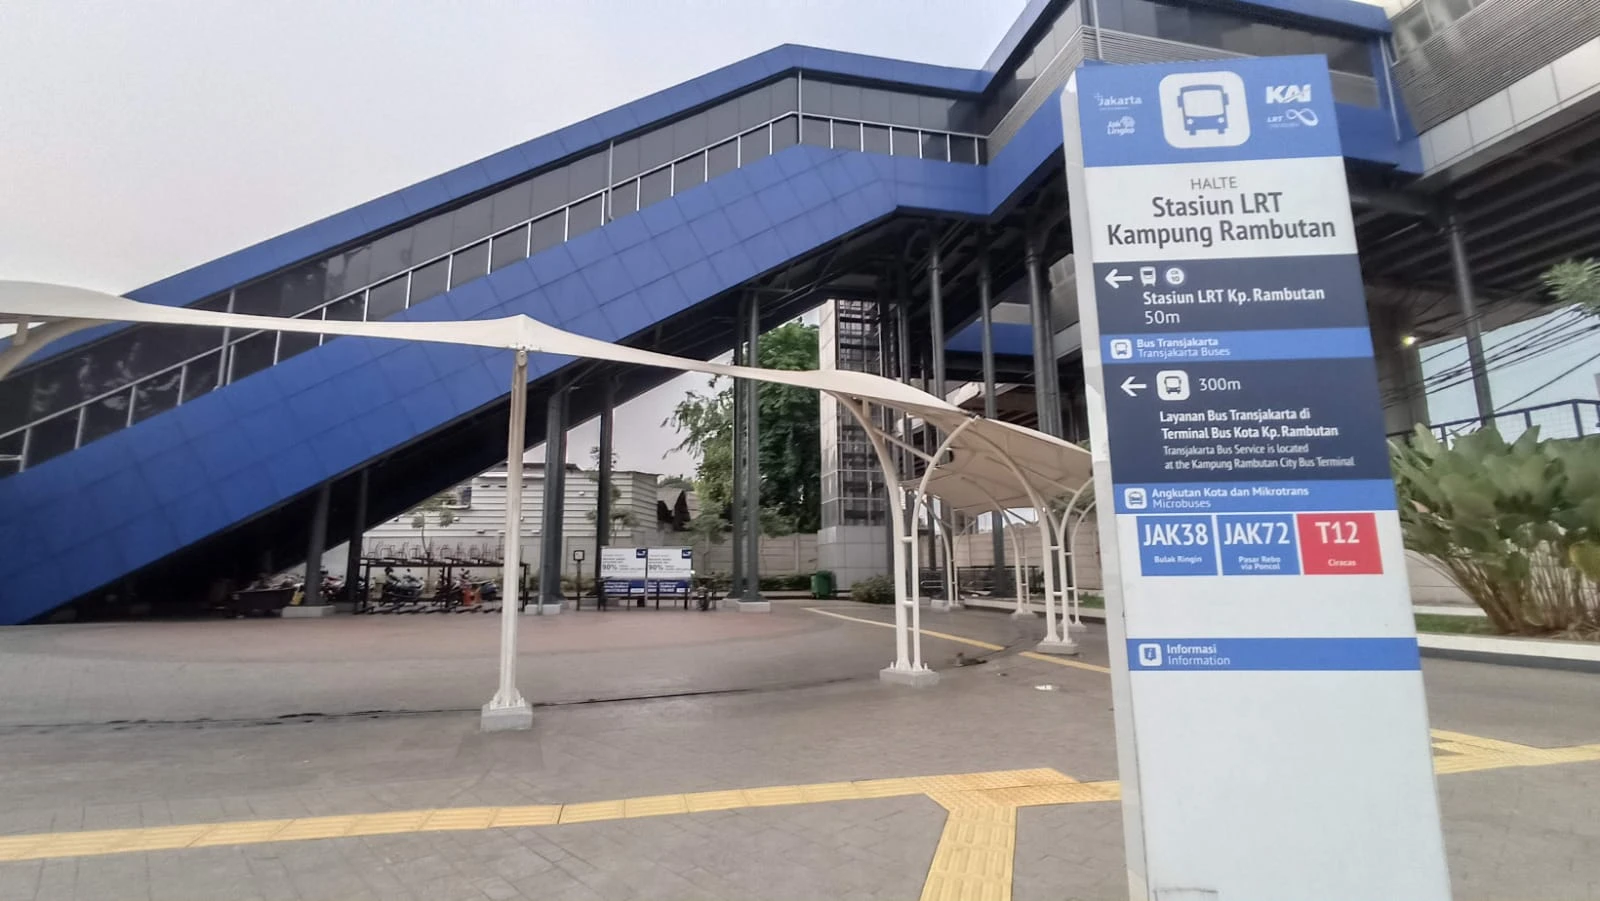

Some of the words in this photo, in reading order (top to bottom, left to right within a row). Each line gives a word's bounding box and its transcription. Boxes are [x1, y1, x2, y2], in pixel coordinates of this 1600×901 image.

[1266, 84, 1311, 104] KAI
[1190, 176, 1238, 190] HALTE
[1152, 195, 1234, 218] Stasiun
[1240, 192, 1282, 214] LRT
[1108, 224, 1213, 249] Kampung
[1219, 218, 1336, 242] Rambutan
[1143, 291, 1194, 305] Stasiun
[1198, 290, 1224, 303] LRT
[1228, 289, 1250, 305] Kp.
[1253, 287, 1325, 301] Rambutan
[1144, 310, 1180, 325] 50m
[1136, 339, 1155, 348] Bus
[1158, 337, 1218, 348] Transjakarta
[1138, 348, 1198, 359] Transjakarta
[1200, 347, 1231, 357] Buses
[1199, 378, 1241, 391] 300m
[1160, 411, 1205, 424] Layanan
[1208, 410, 1228, 422] Bus
[1230, 408, 1296, 422] Transjakarta
[1299, 408, 1310, 420] di
[1161, 427, 1210, 440] Terminal
[1212, 427, 1232, 438] Bus
[1234, 426, 1260, 438] Kota
[1262, 426, 1280, 440] Kp.
[1282, 426, 1339, 438] Rambutan
[1164, 446, 1215, 456] Transjakarta
[1216, 444, 1232, 454] Bus
[1234, 444, 1266, 454] Service
[1267, 444, 1276, 453] is
[1276, 443, 1309, 454] located
[1164, 460, 1174, 470] at
[1176, 459, 1190, 469] the
[1192, 459, 1232, 470] Kampung
[1234, 458, 1278, 468] Rambutan
[1280, 457, 1297, 469] City
[1299, 457, 1314, 467] Bus
[1316, 456, 1355, 467] Terminal
[1152, 488, 1201, 501] Angkutan
[1204, 488, 1228, 498] Kota
[1230, 486, 1250, 498] dan
[1252, 486, 1309, 497] Mikrotrans
[1152, 497, 1211, 509] Microbuses
[1143, 524, 1209, 547] JAK38
[1224, 522, 1290, 546] JAK72
[1315, 521, 1360, 544] T12
[1177, 556, 1202, 564] Ringin
[1328, 558, 1356, 567] Ciracas
[1167, 644, 1216, 654] Informasi
[1168, 655, 1230, 666] Information
